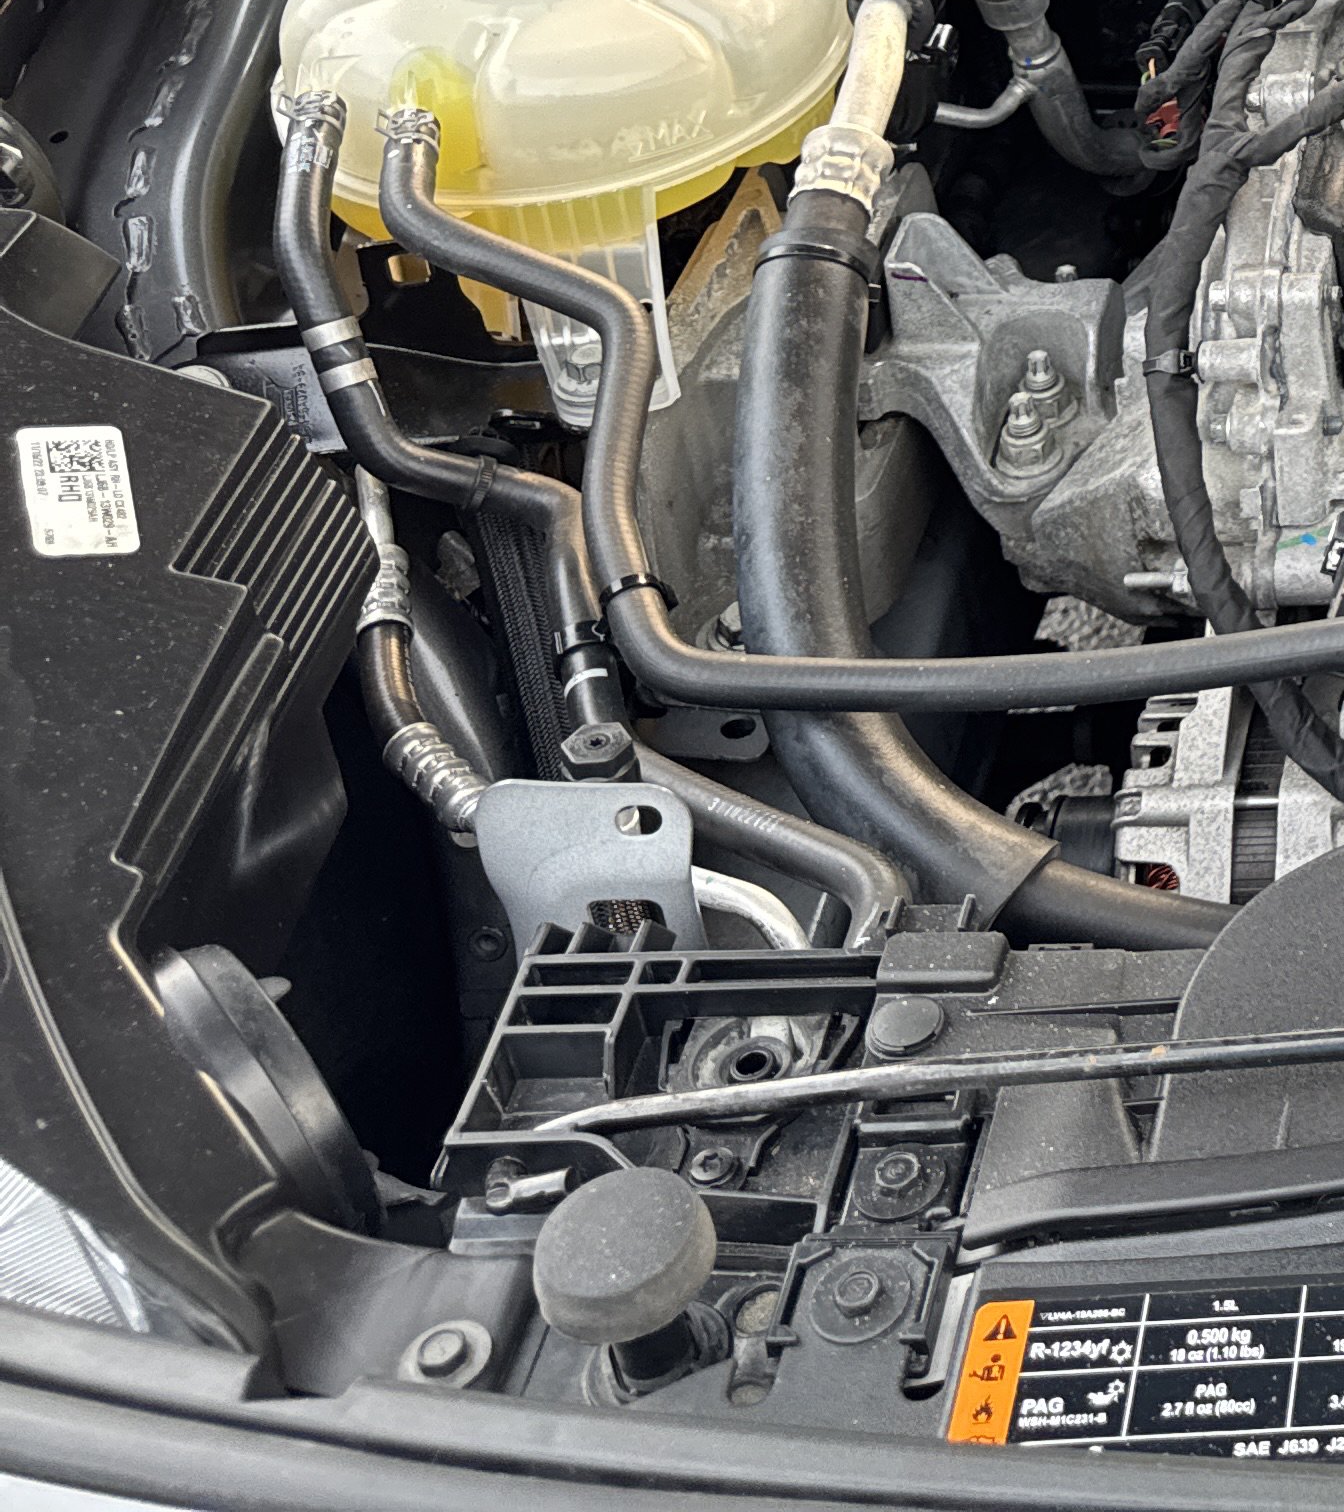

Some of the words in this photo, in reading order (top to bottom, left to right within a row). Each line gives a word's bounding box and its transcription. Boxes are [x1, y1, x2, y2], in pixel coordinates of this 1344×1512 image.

[1212, 1299, 1239, 1312] 1.5L
[1186, 1327, 1228, 1346] 0.500
[1231, 1326, 1251, 1345] kg
[1029, 1338, 1111, 1361] R-1234yf
[1188, 1349, 1203, 1361] oz
[1206, 1345, 1238, 1363] (1.10
[1240, 1343, 1265, 1360] lbs)
[1195, 1383, 1227, 1398] PAG
[1020, 1397, 1064, 1415] PAG
[1161, 1401, 1182, 1417] 2.7
[1197, 1403, 1213, 1415] oz
[1233, 1440, 1271, 1457] SAE
[1278, 1438, 1319, 1455] J639
